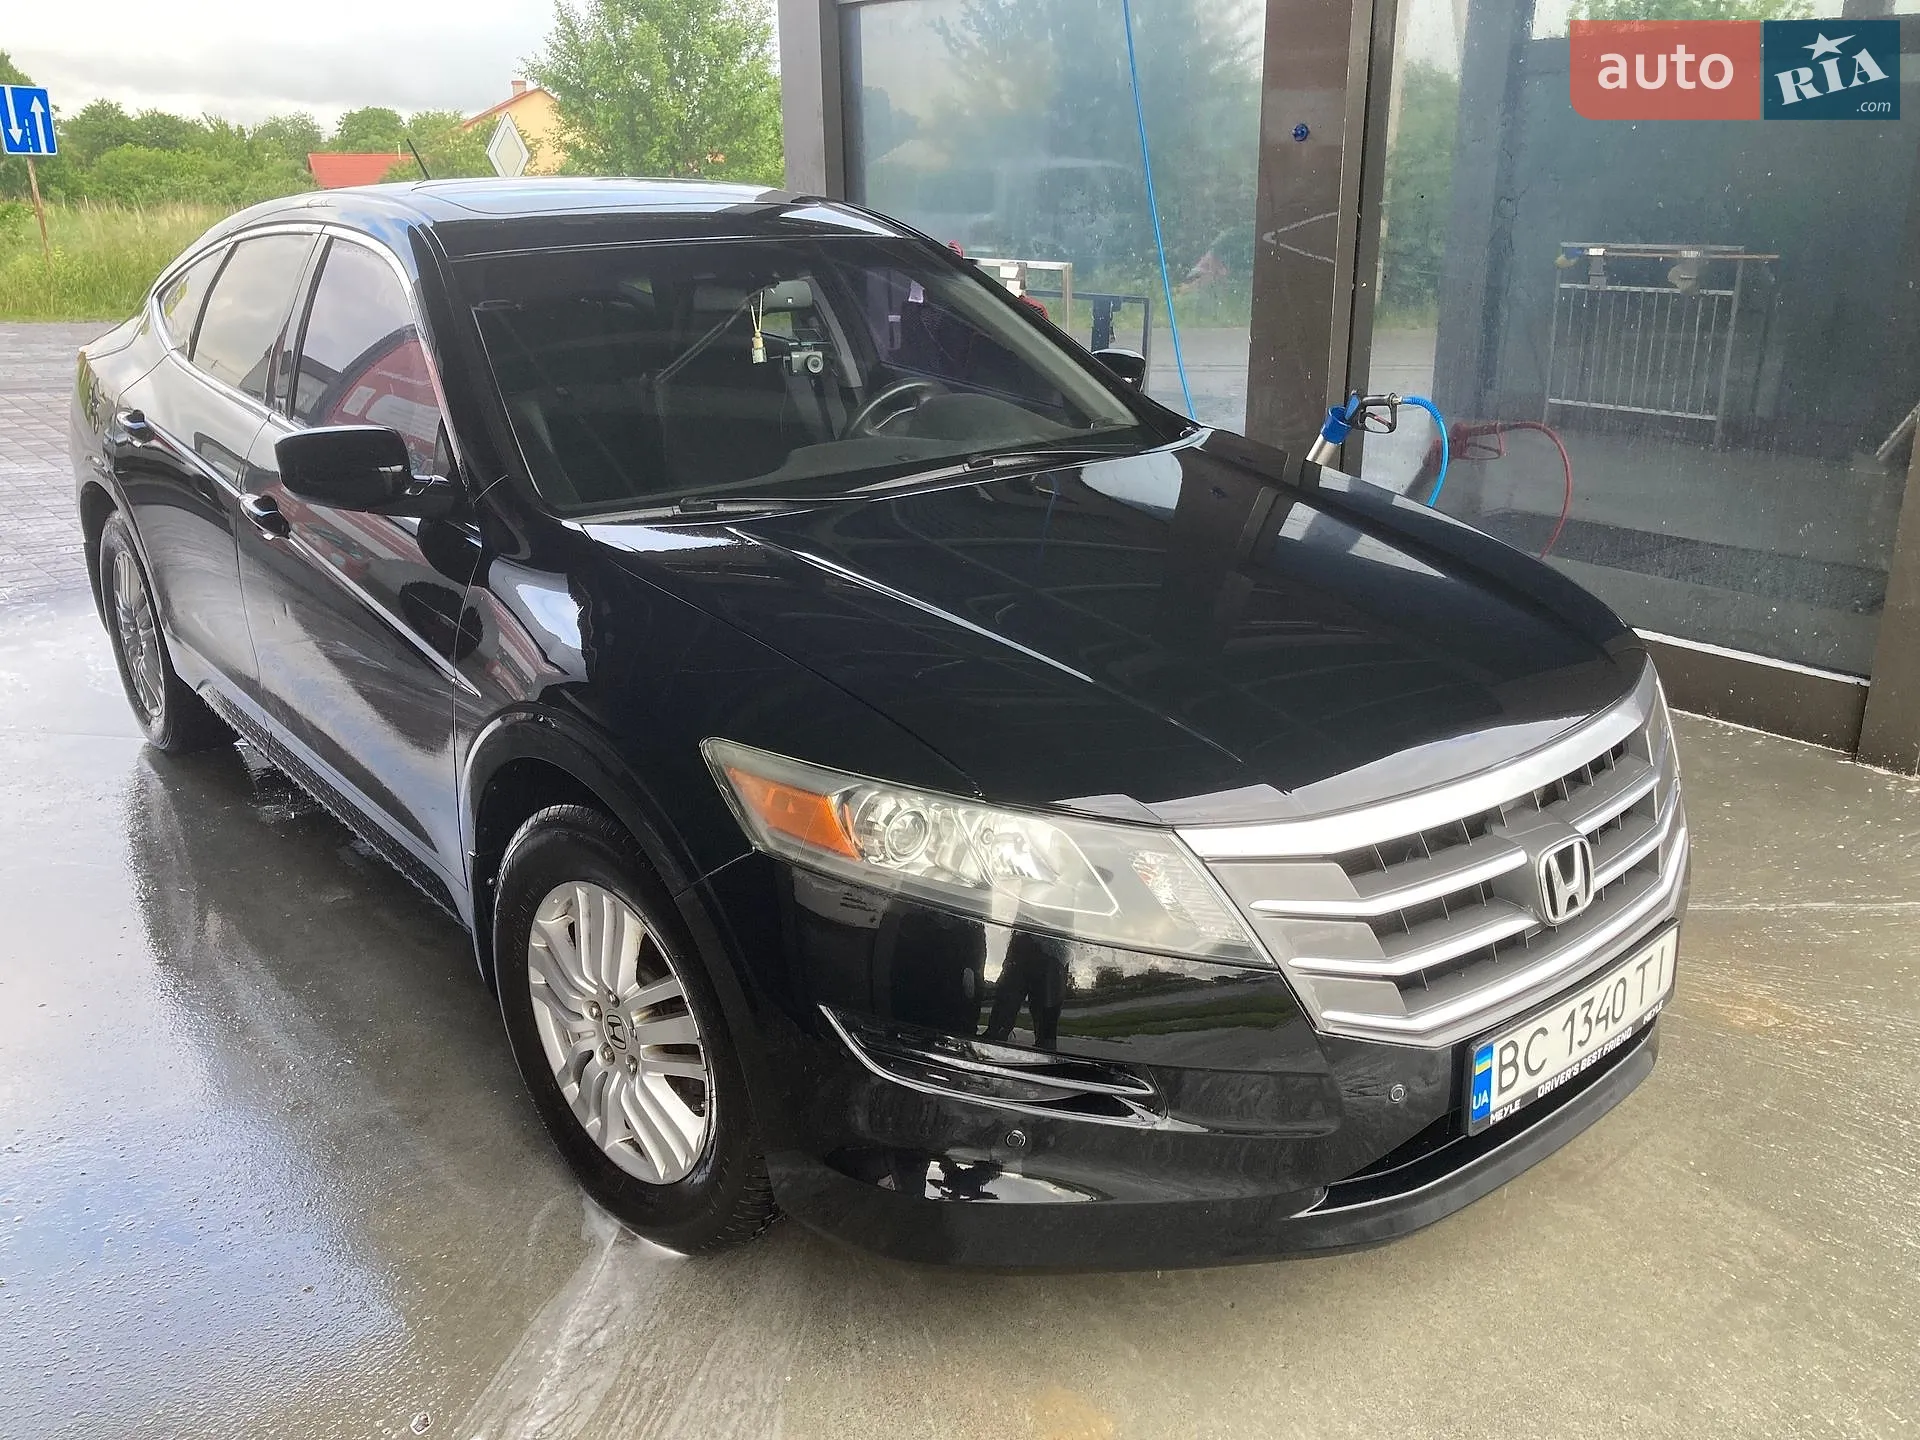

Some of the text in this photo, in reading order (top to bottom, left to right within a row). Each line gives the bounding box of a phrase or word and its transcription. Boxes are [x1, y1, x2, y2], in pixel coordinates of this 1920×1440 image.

[1489, 1099, 1521, 1125] MEYLE
[1537, 1062, 1580, 1098] DRIVER'S
[1580, 1047, 1604, 1072] BEST
[1602, 1026, 1633, 1056] FRIEND
[1497, 1027, 1548, 1097] BC
[1562, 976, 1627, 1057] 1340
[1472, 1089, 1489, 1110] UA
